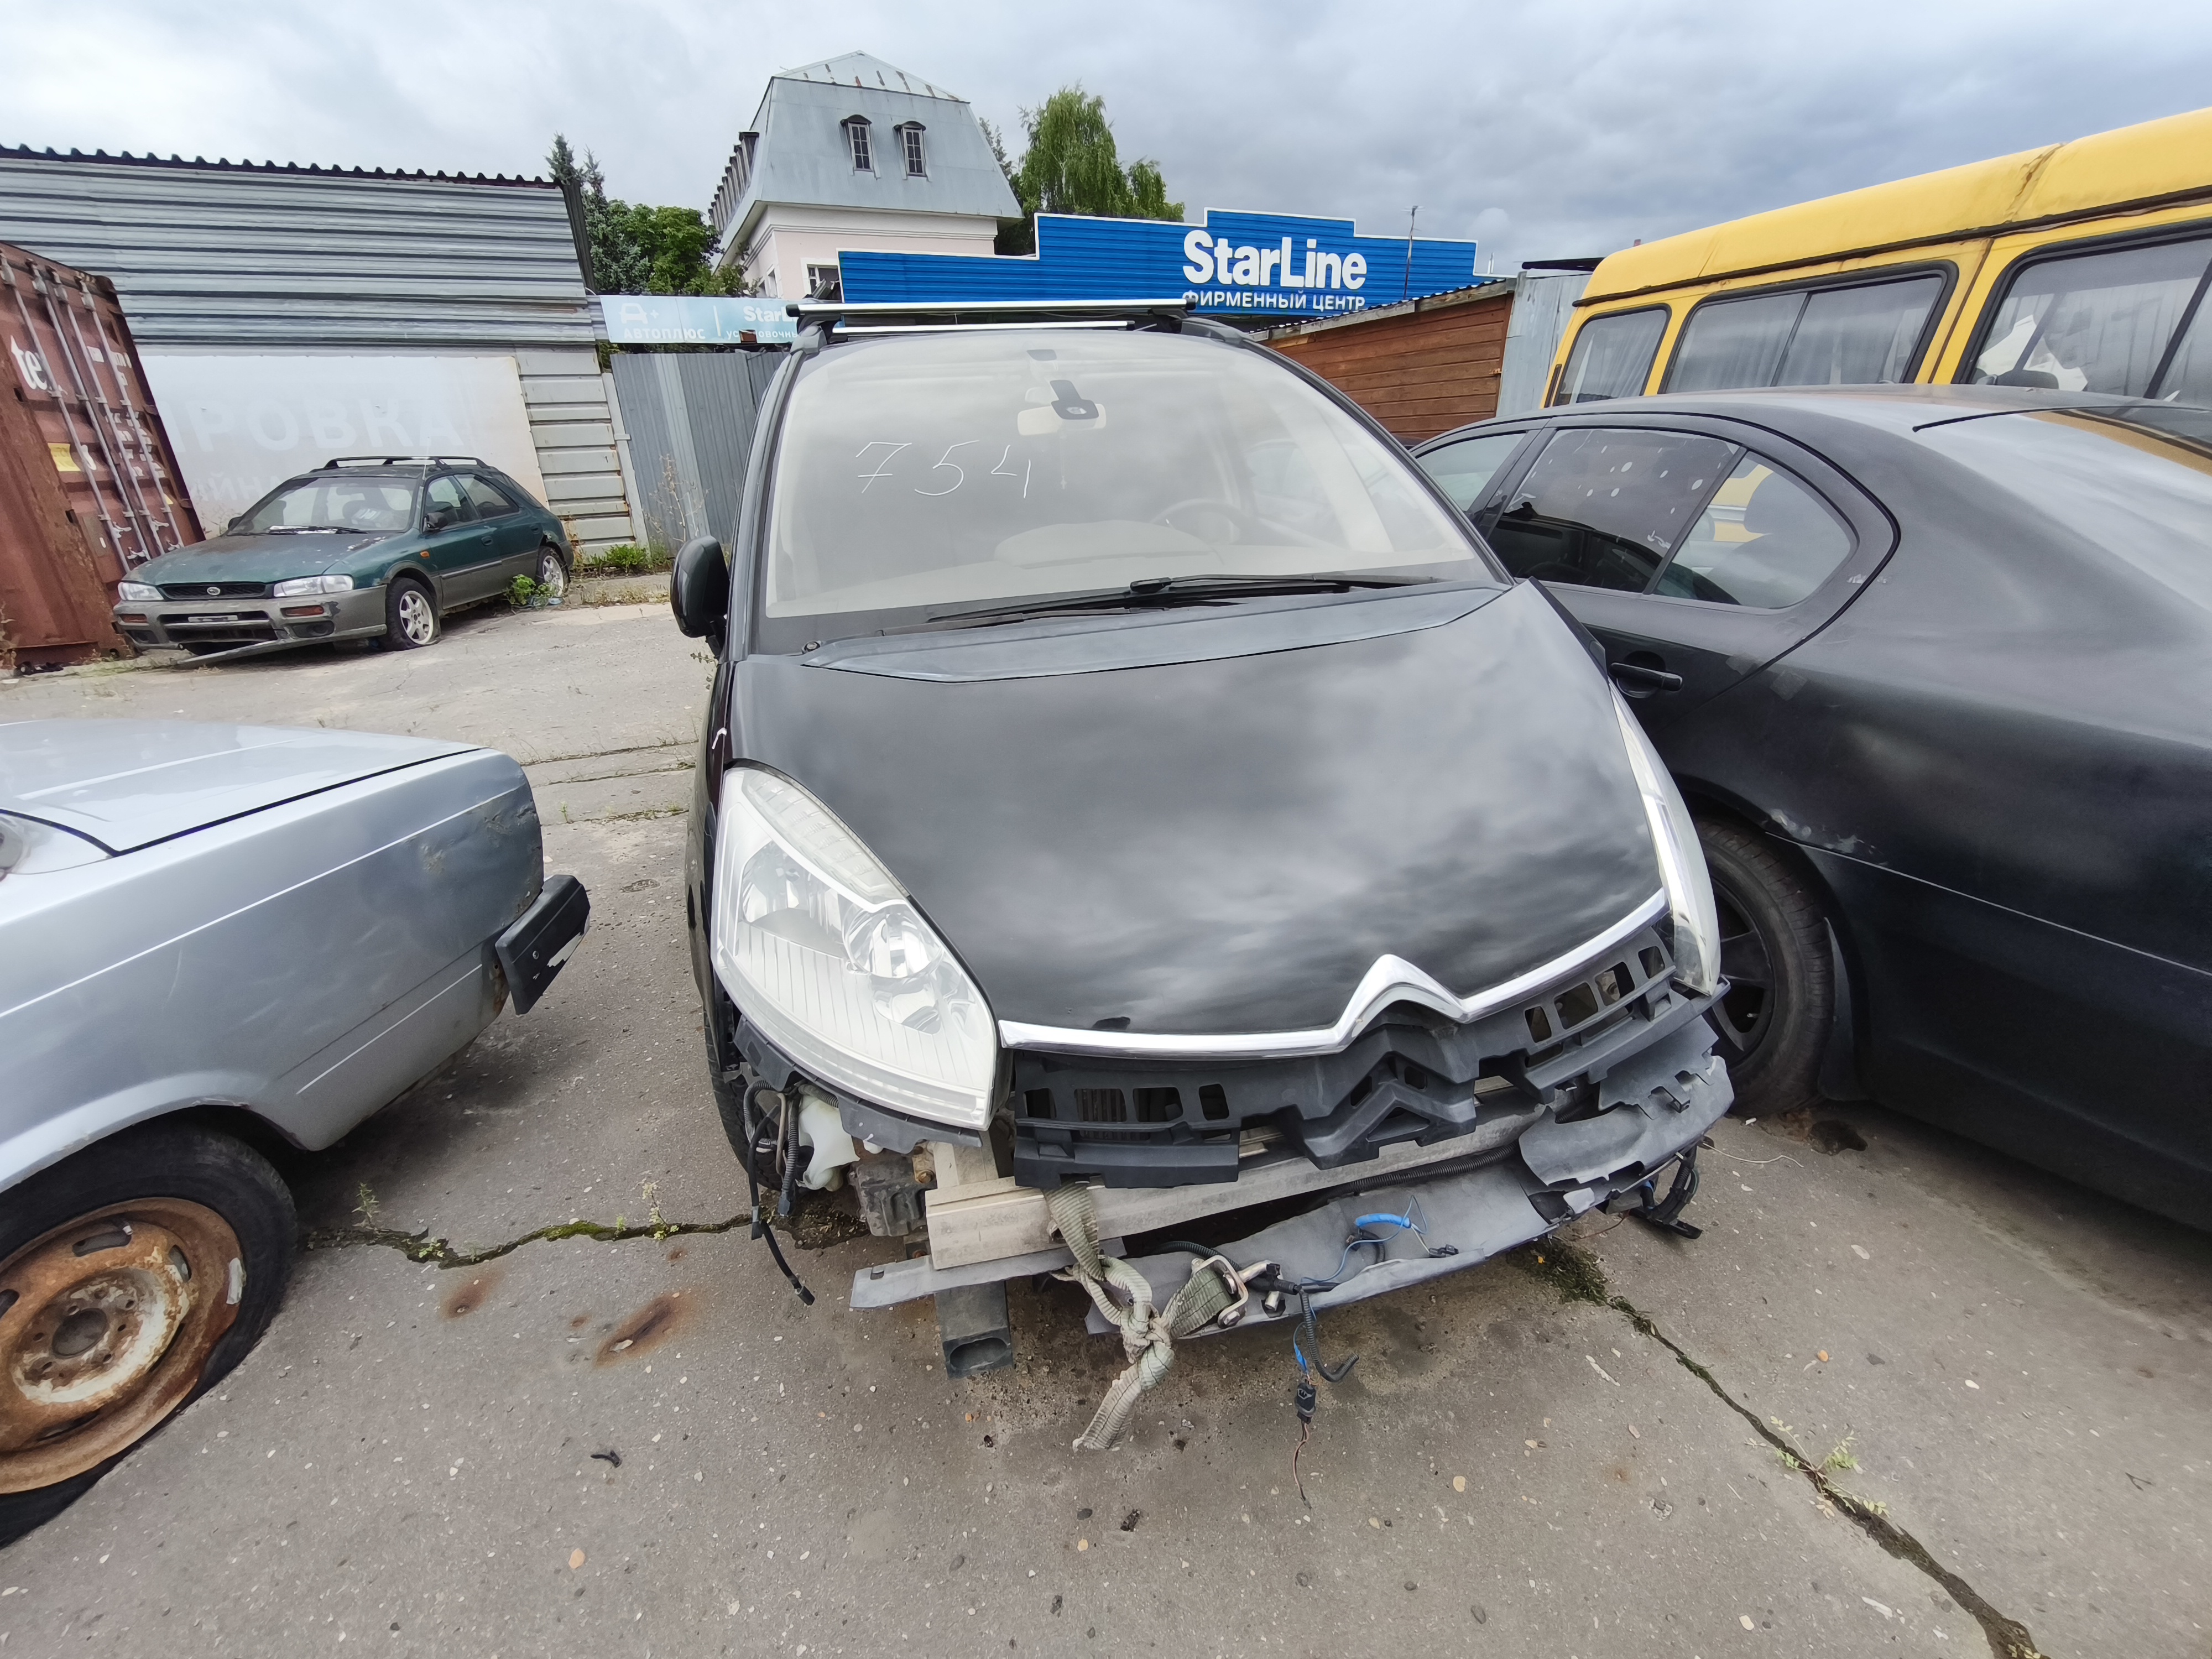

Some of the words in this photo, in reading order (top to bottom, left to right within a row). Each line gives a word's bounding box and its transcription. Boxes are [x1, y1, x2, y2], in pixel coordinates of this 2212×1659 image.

[1182, 229, 1368, 290] StarLine
[1182, 290, 1307, 309] ФИРМЕННЫЙ
[1313, 294, 1365, 311] ЦЕНТР
[624, 328, 706, 340] АВТОПЛЮС
